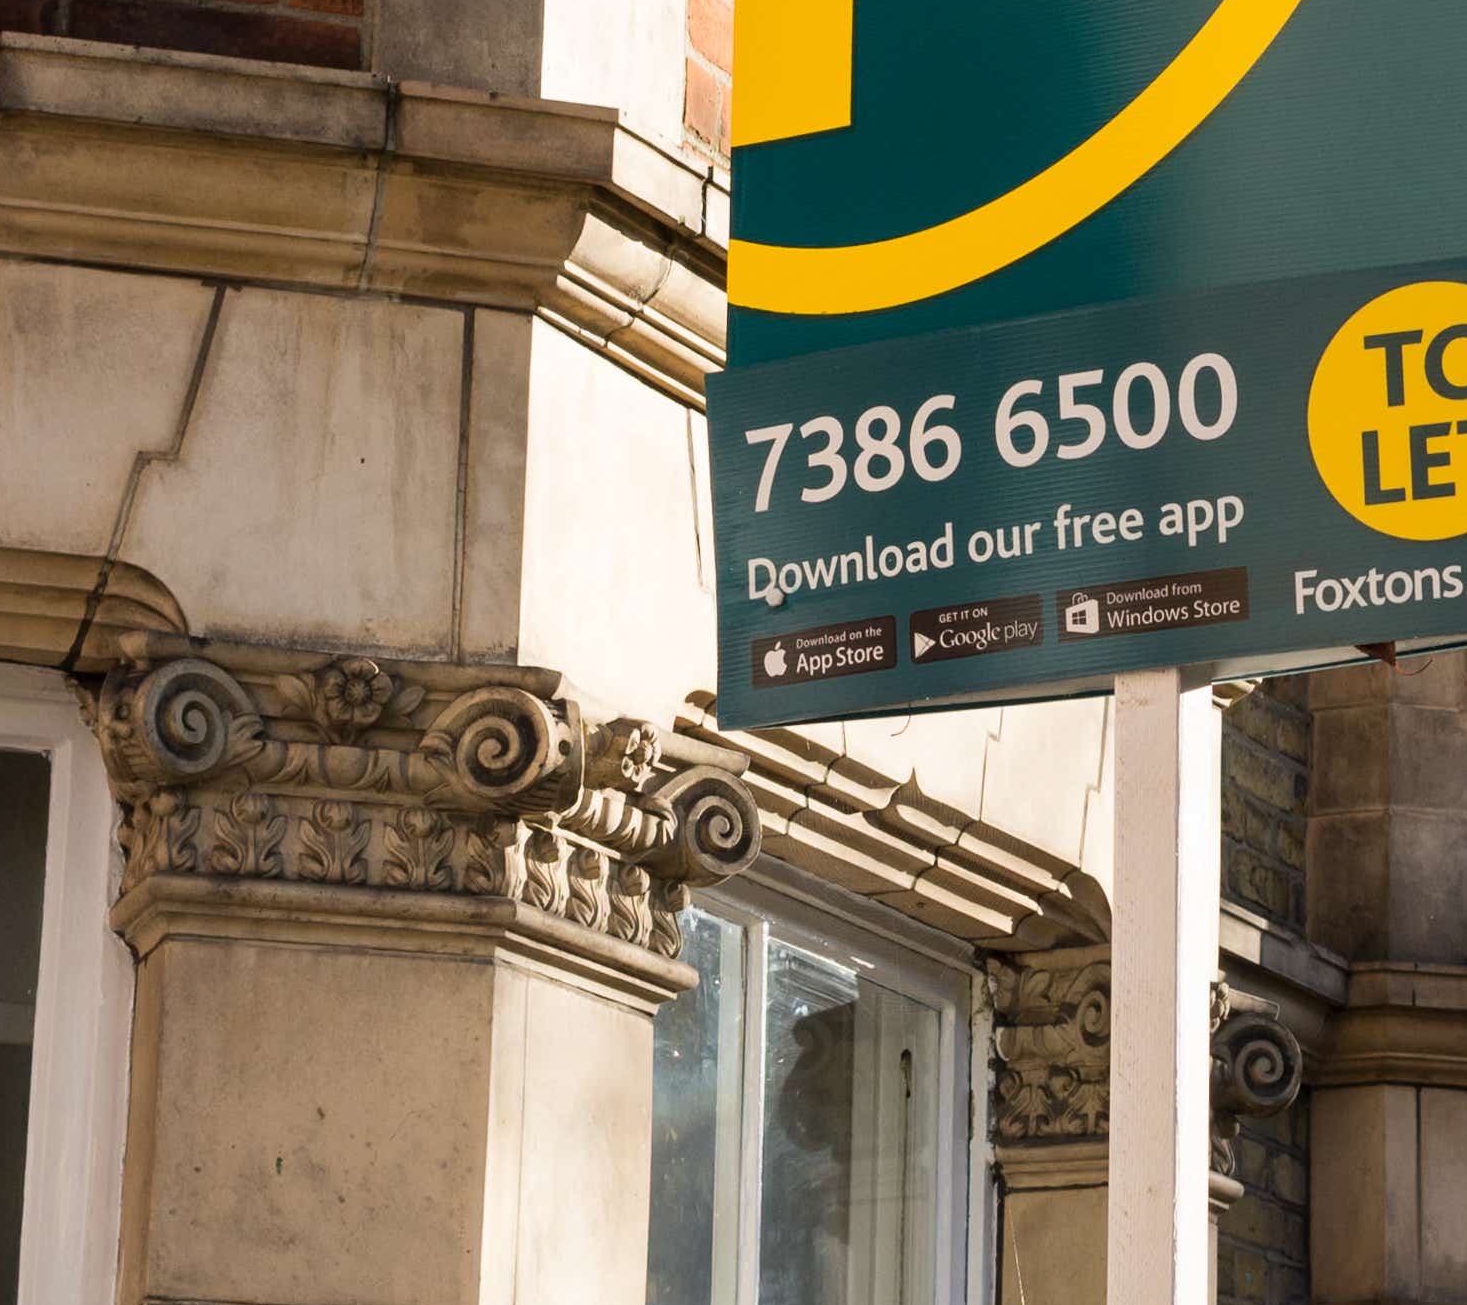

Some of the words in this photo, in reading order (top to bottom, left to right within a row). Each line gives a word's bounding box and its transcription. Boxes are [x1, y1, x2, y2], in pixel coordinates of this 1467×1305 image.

[745, 395, 962, 513] 7386
[995, 352, 1238, 468] 6500
[748, 522, 954, 600] Download
[968, 520, 1041, 563] our
[1054, 504, 1144, 549] free
[1160, 495, 1245, 546] app
[1107, 587, 1168, 605] Download
[1171, 582, 1202, 596] from
[939, 612, 959, 624] GET
[961, 610, 970, 620] IT
[972, 607, 988, 618] ON
[1107, 604, 1189, 629] Windows
[1193, 599, 1241, 619] Store
[796, 630, 846, 649] Download
[849, 631, 863, 641] on
[865, 626, 883, 638] the
[939, 624, 1001, 649] Google
[1004, 621, 1038, 642] play
[796, 652, 833, 675] App
[835, 645, 884, 668] Store
